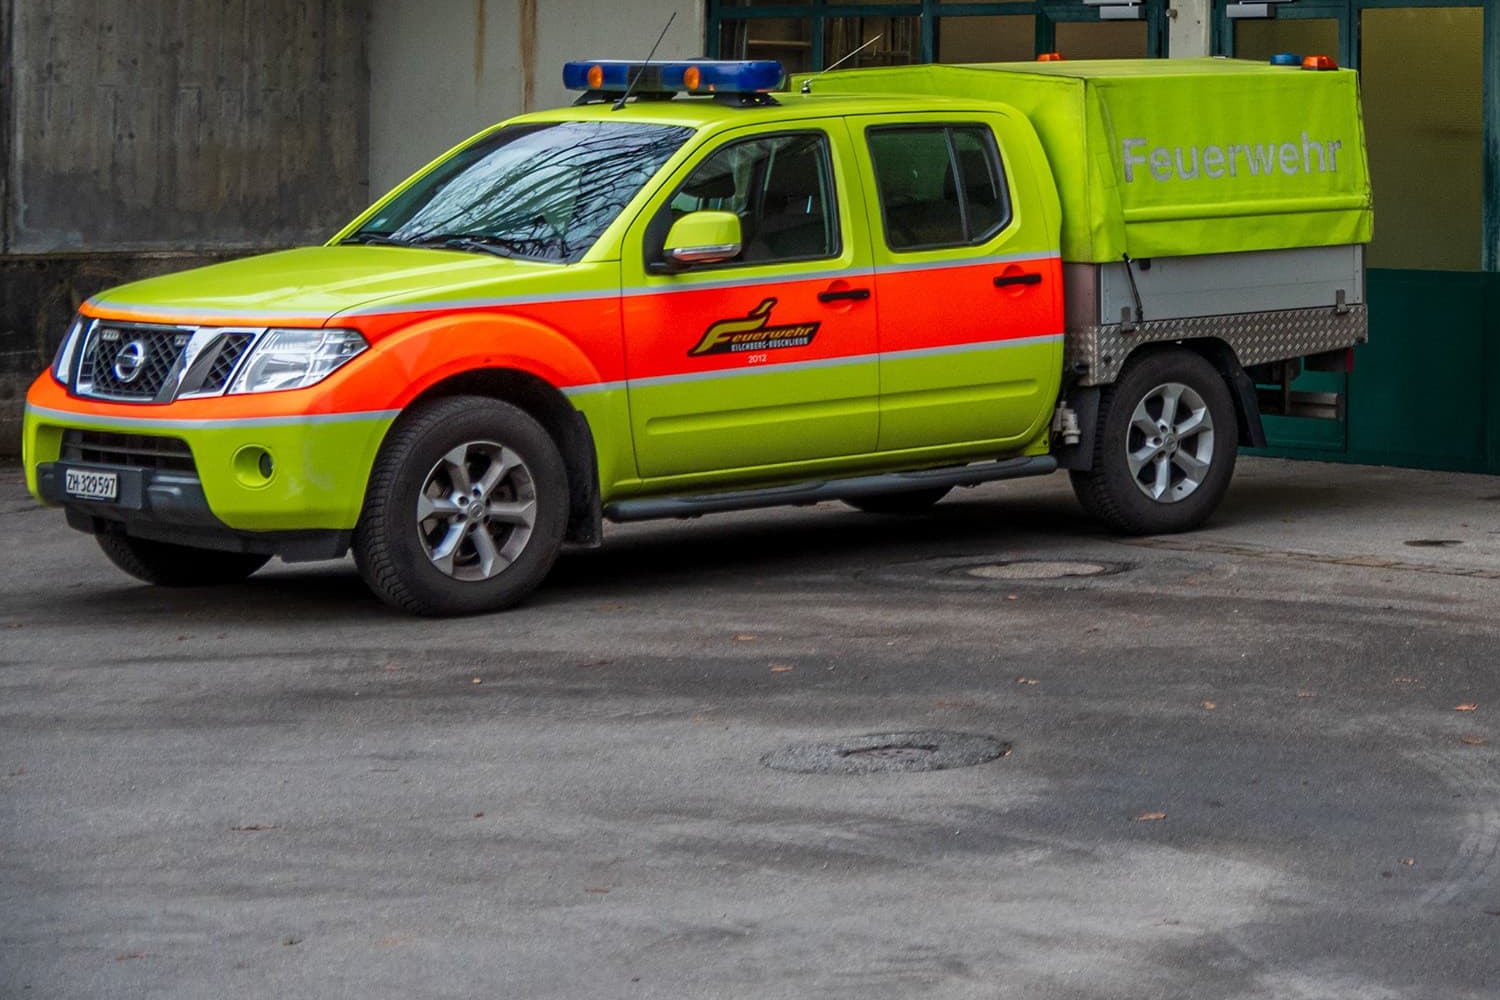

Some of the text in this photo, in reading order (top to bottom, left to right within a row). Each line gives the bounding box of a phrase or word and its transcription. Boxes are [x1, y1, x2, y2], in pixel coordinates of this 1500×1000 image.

[1121, 131, 1342, 183] Feuerwehr
[692, 300, 814, 354] Feuerwehr
[748, 354, 768, 364] 2012
